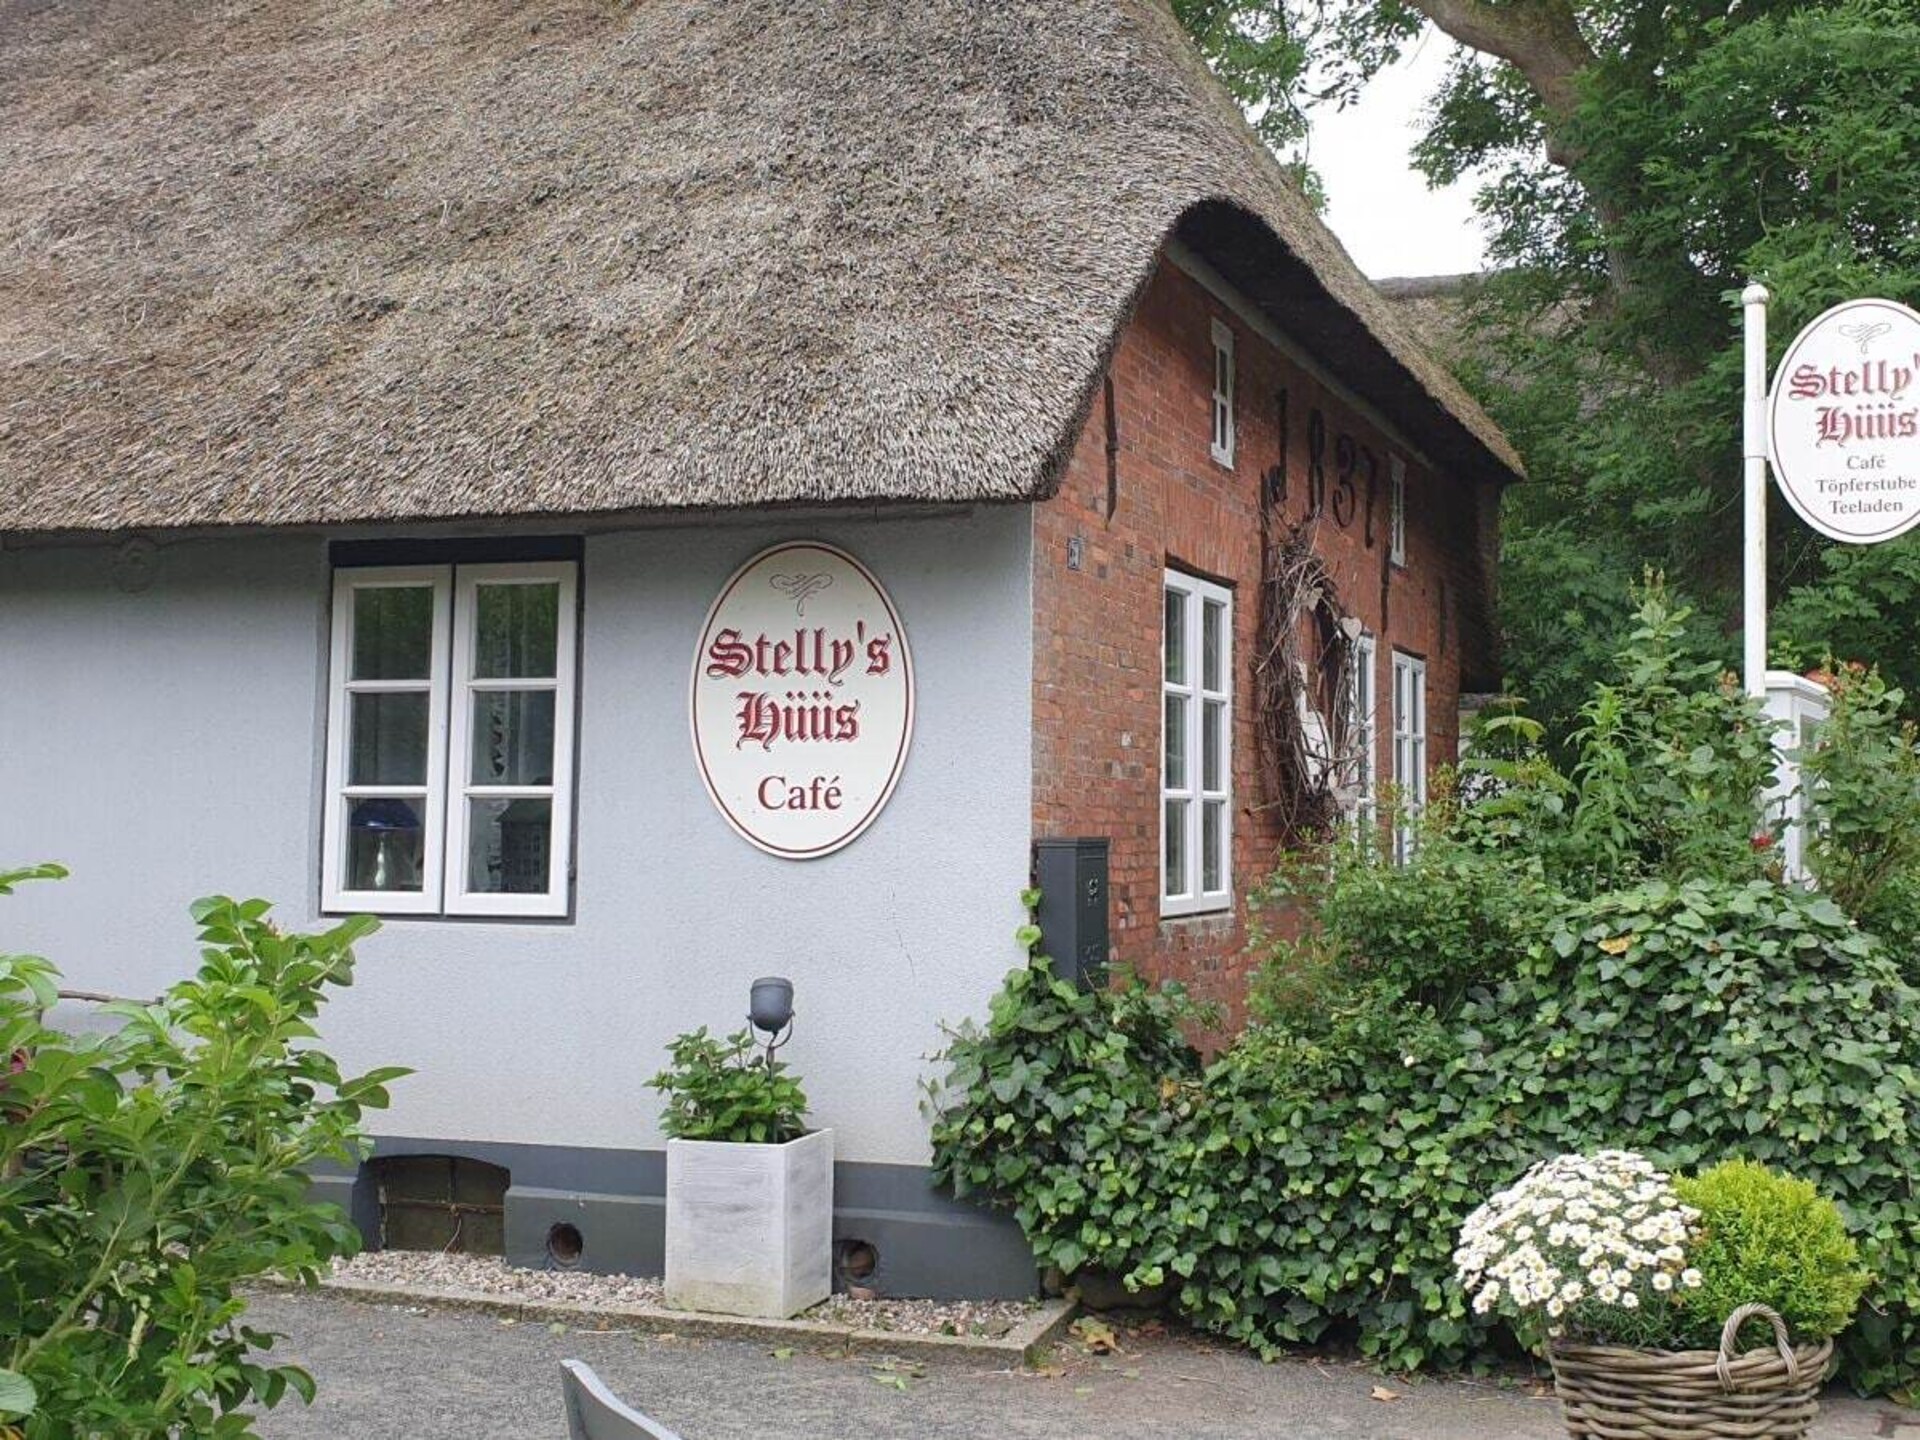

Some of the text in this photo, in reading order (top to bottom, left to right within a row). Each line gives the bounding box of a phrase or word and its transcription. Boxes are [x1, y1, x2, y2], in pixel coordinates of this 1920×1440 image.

[1788, 353, 1920, 401] Stelly'
[1846, 455, 1886, 470] Café
[1815, 477, 1916, 496] Töpferstube
[1829, 499, 1904, 515] Teeladen
[706, 620, 892, 686] Stelly's
[735, 690, 862, 752] Hüüs
[757, 775, 842, 811] Café
